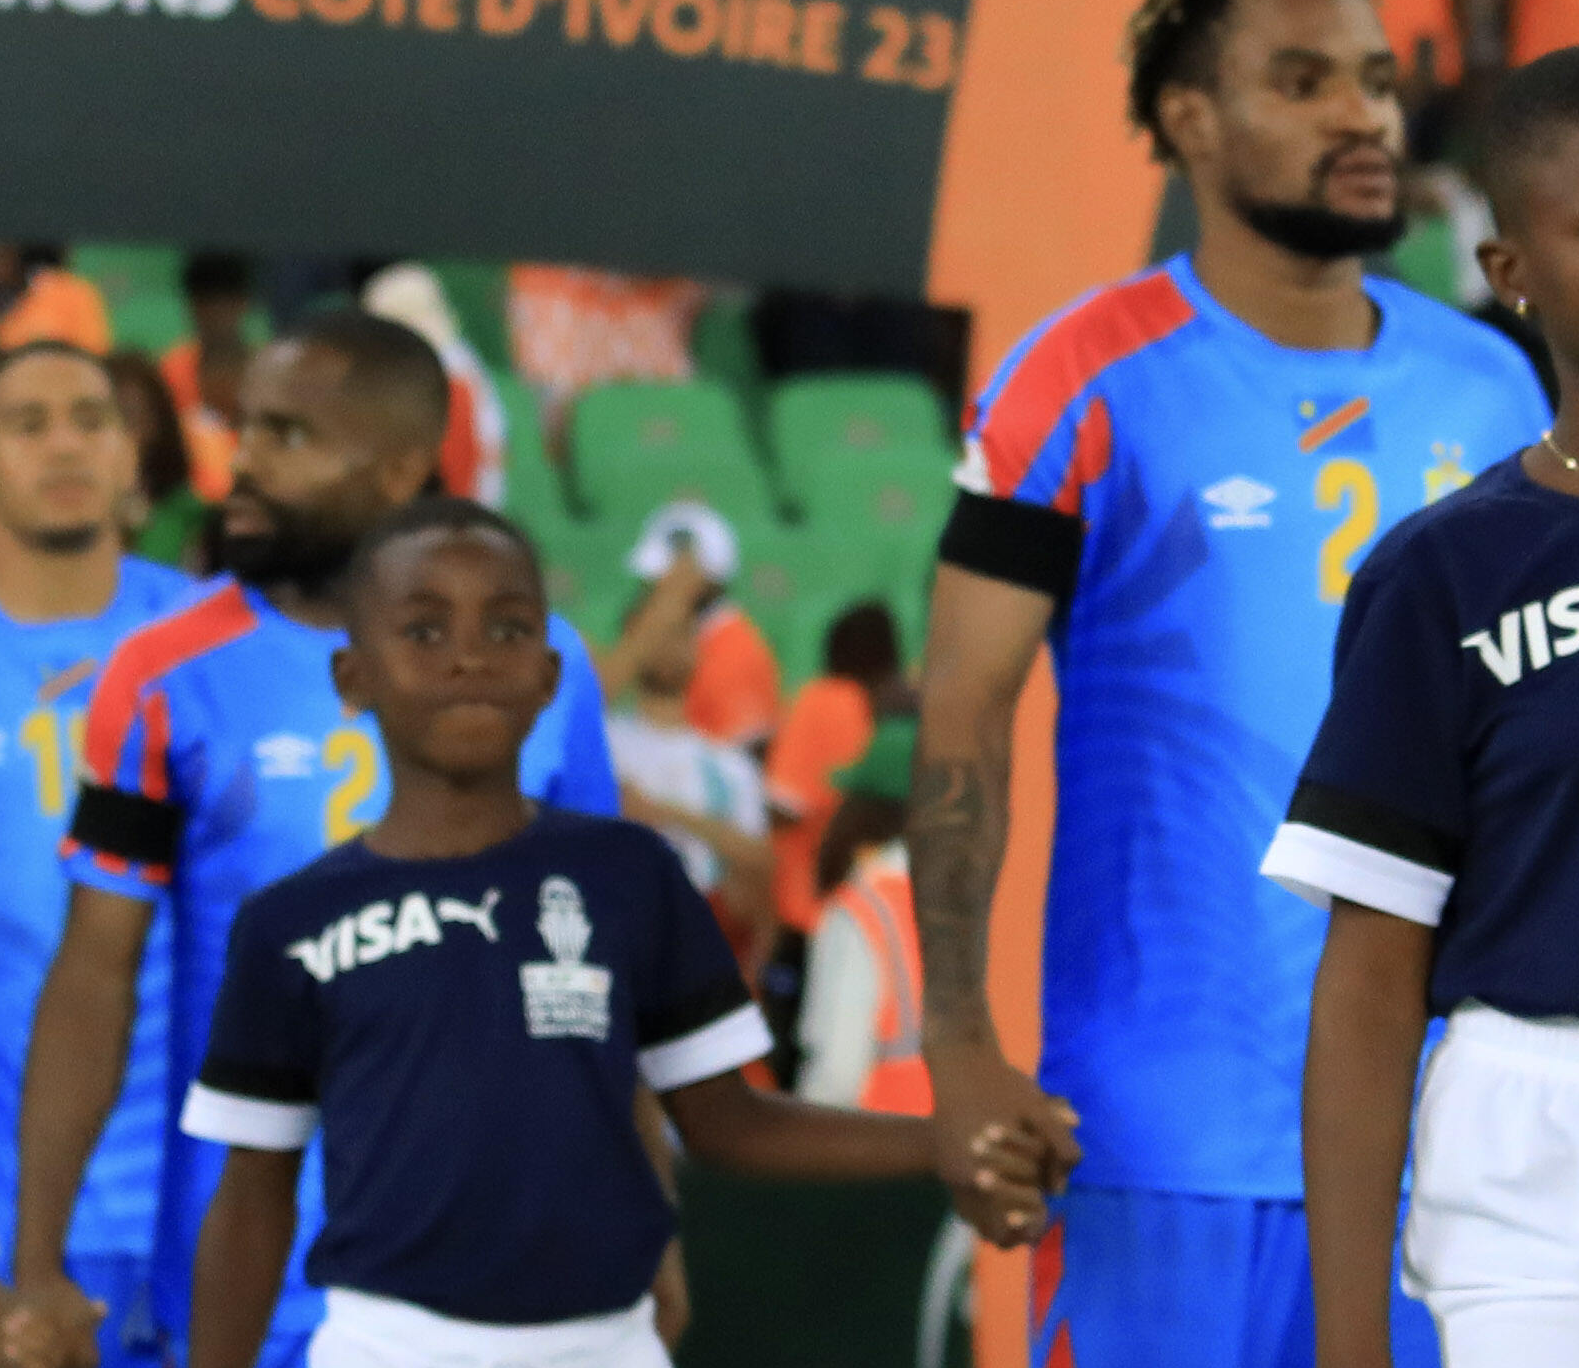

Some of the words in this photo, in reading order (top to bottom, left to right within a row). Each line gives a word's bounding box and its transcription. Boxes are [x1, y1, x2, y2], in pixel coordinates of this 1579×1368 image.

[861, 5, 954, 90] 23
[1315, 459, 1380, 605] 2
[21, 709, 87, 816] 1
[287, 893, 440, 983] VISA
